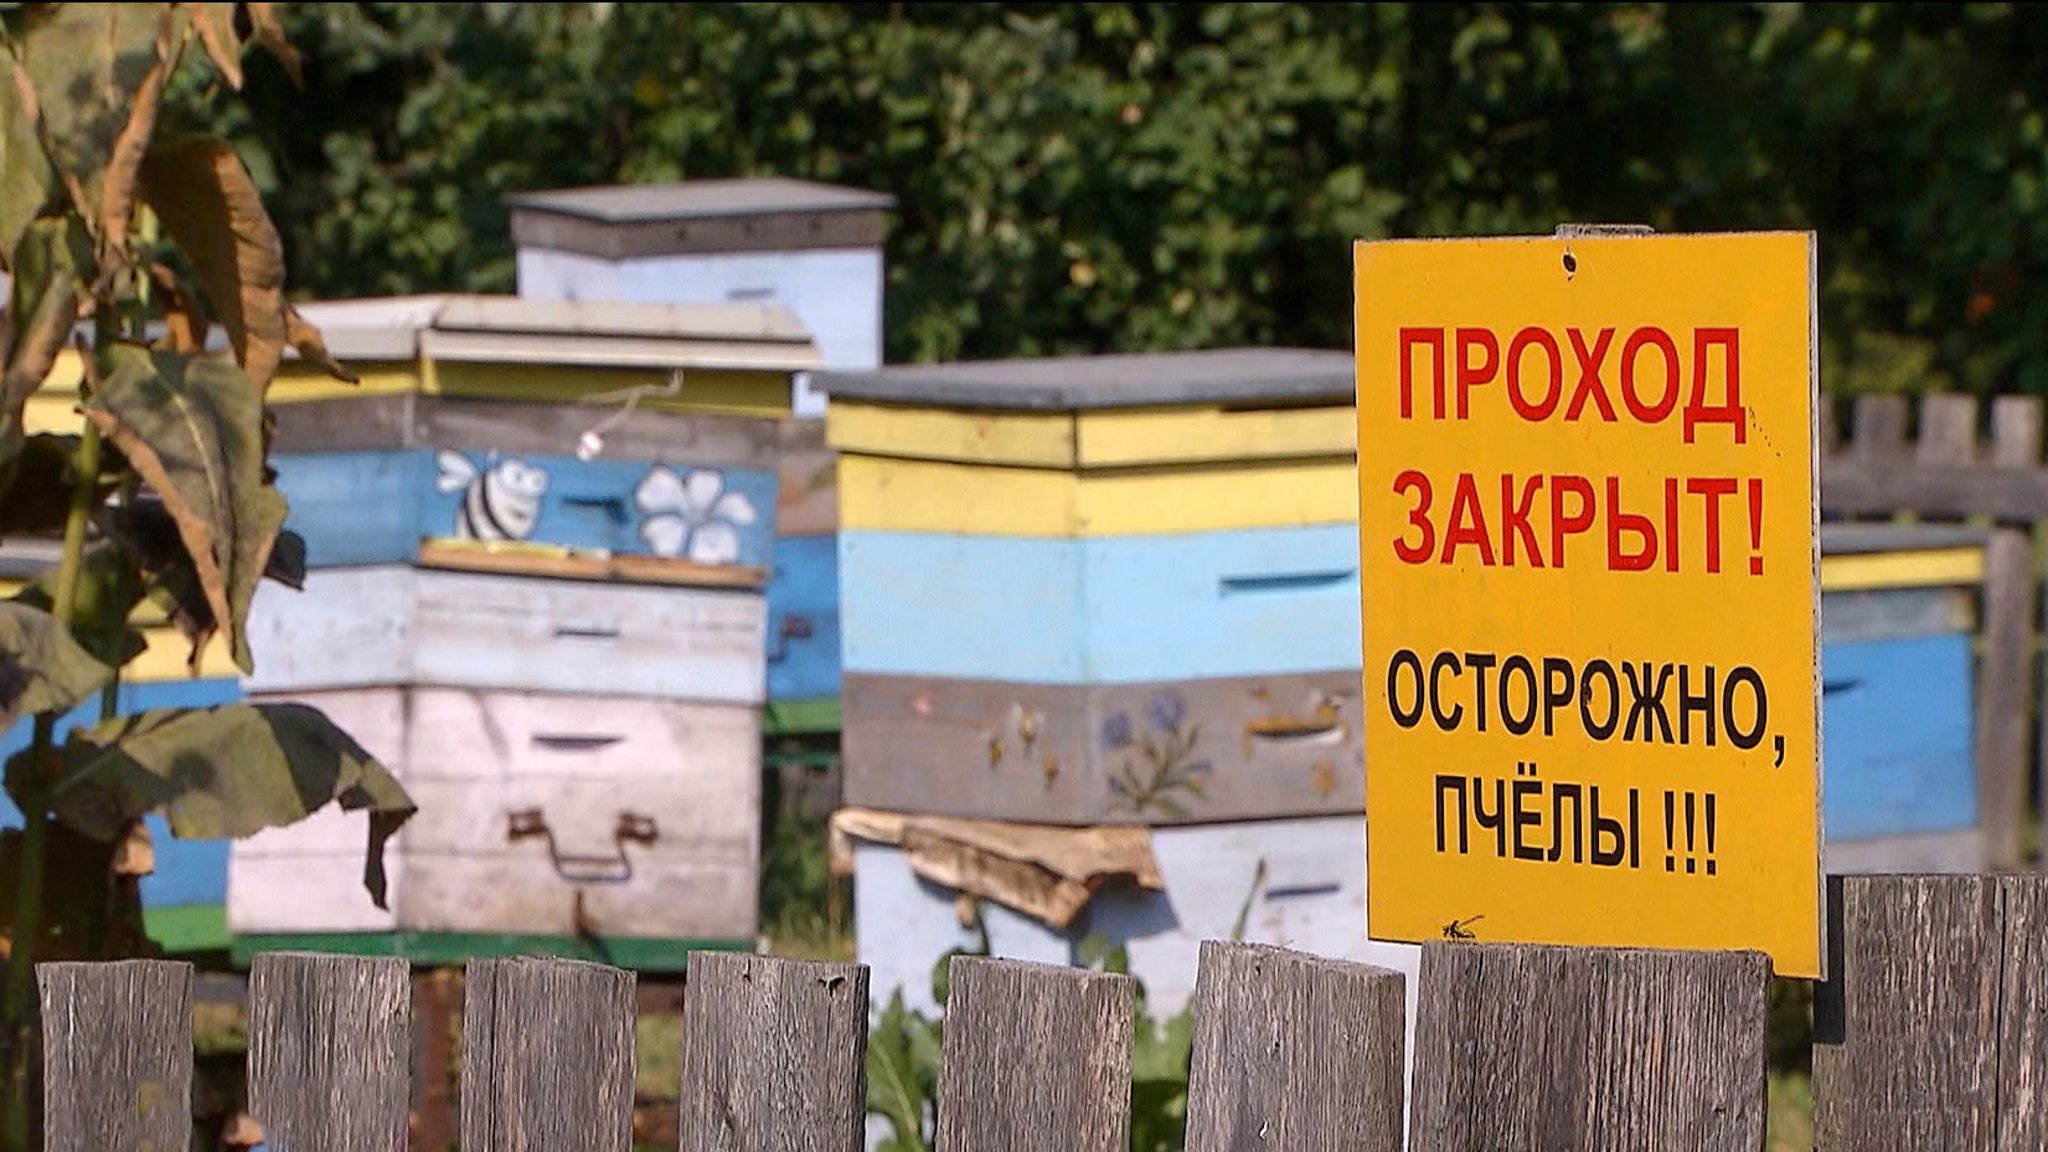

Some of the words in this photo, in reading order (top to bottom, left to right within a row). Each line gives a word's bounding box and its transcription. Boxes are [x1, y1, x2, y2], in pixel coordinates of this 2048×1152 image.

[1399, 326, 1747, 445] ПРОХОД
[1392, 470, 1764, 576] ЗАКРЫТ!
[1387, 649, 1785, 768] ОСТОРОЖНО,
[1435, 761, 1640, 869] ПЧЁЛЫ
[1664, 791, 1716, 876] !!!
